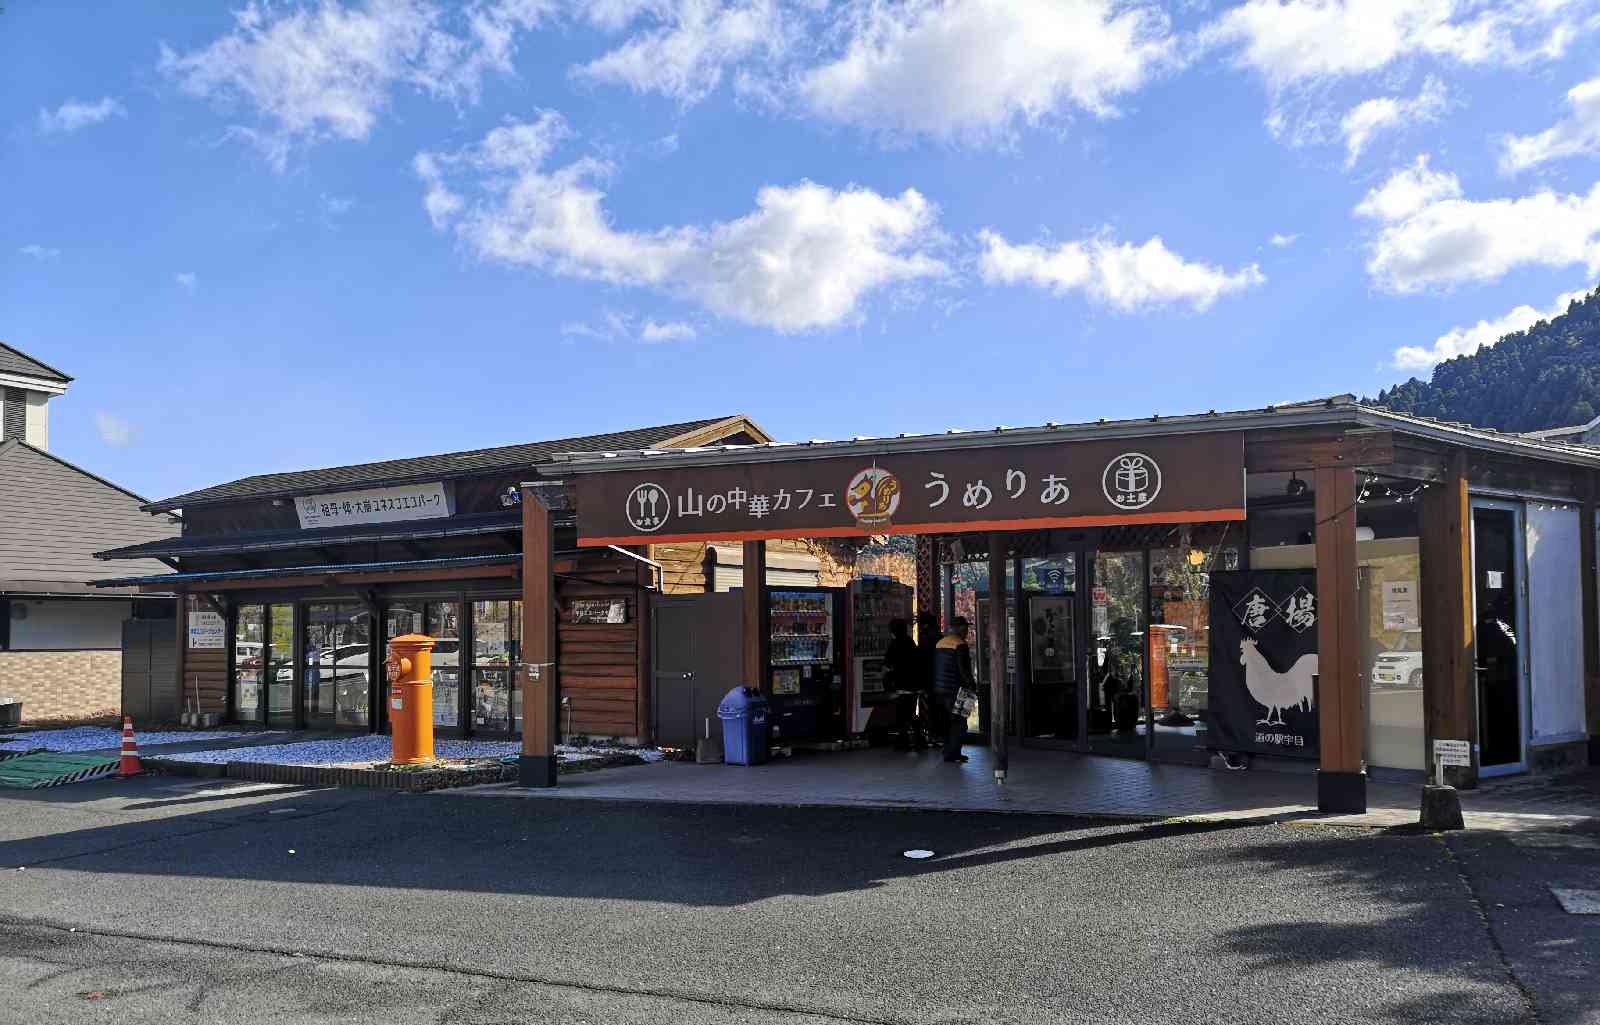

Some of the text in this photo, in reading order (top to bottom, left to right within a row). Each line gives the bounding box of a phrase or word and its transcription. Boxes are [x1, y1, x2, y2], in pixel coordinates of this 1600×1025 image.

[677, 487, 837, 518] 山の中華カフェ
[925, 469, 1070, 509] うめりあ
